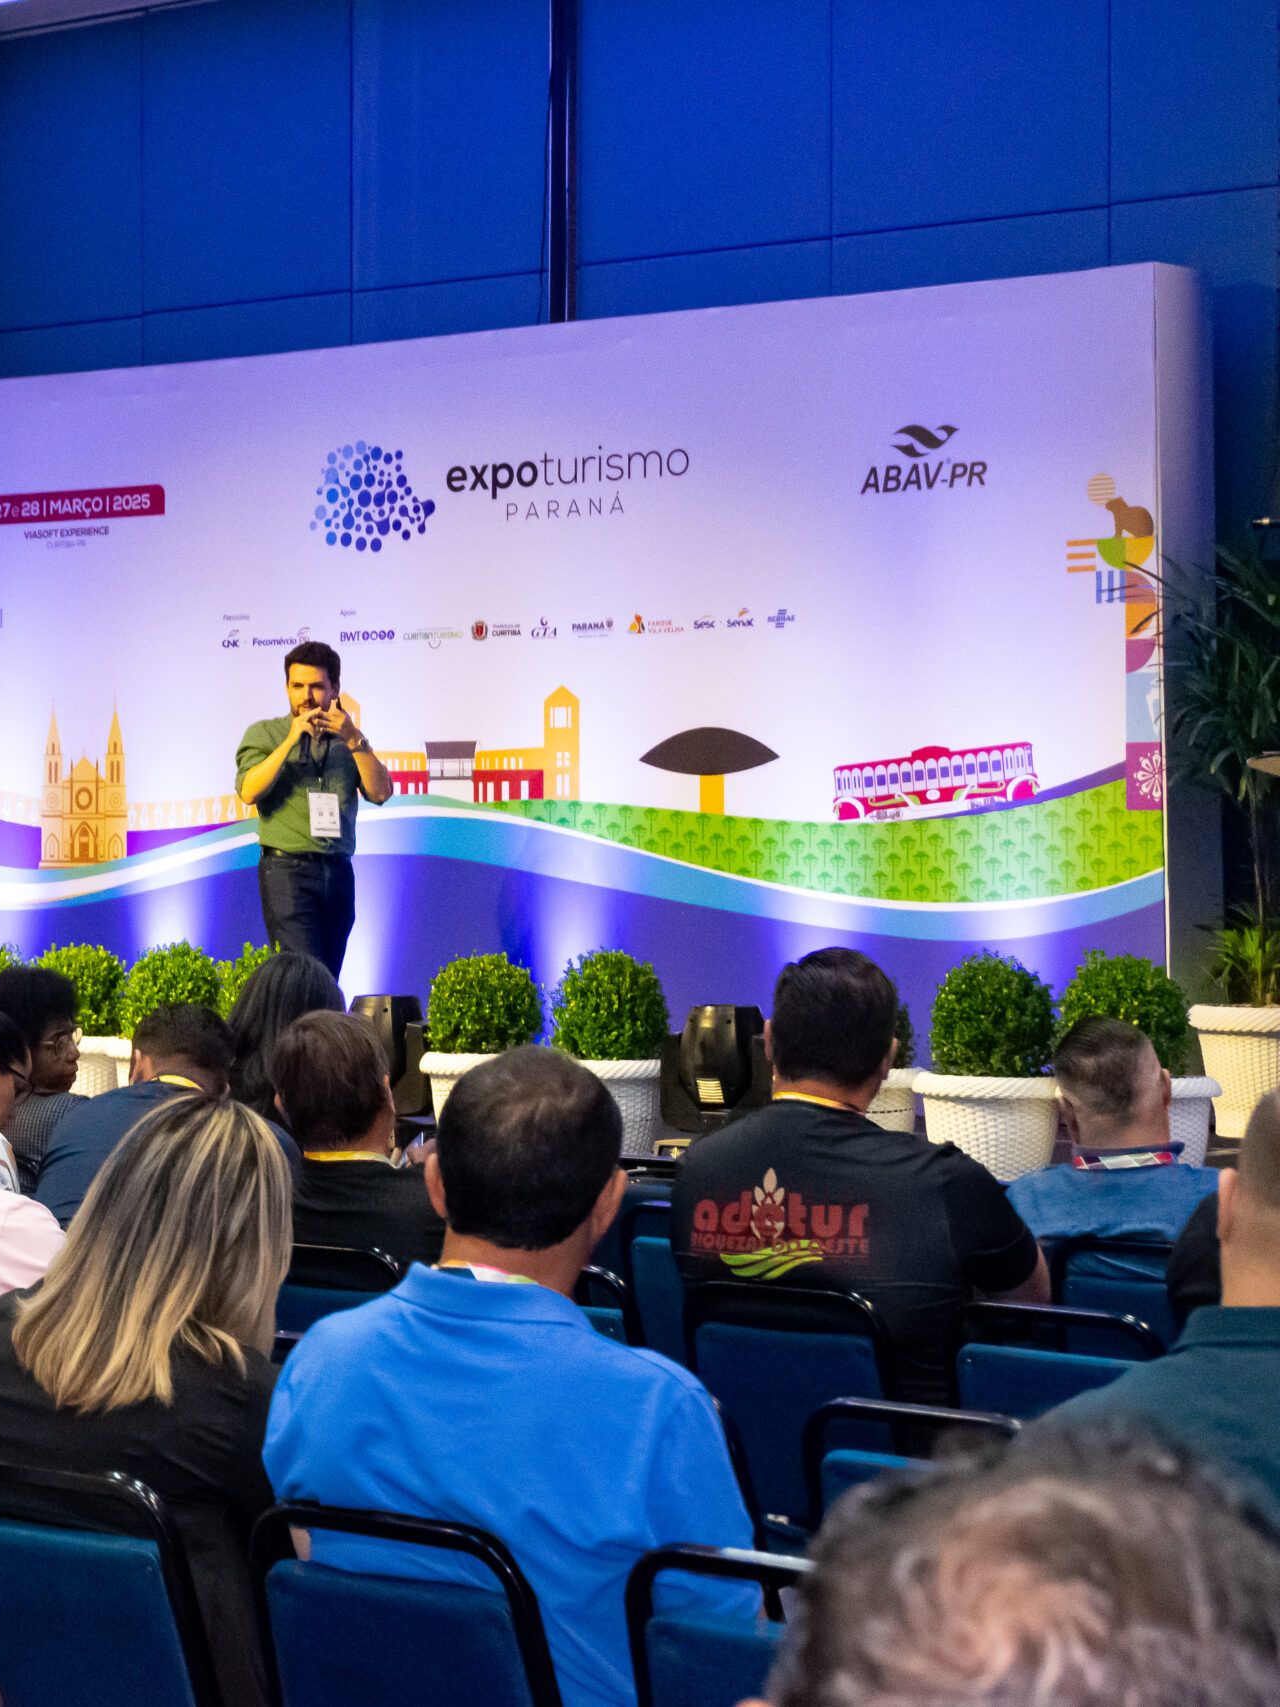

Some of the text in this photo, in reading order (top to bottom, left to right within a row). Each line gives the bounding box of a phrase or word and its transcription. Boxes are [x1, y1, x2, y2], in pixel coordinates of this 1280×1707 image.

[446, 445, 689, 499] expoturismo
[49, 497, 102, 517] MARÇO
[112, 493, 151, 511] 2025
[506, 491, 625, 522] PARANÁ
[24, 526, 110, 540] VIASOFT EXPERIENCE
[492, 629, 521, 637] CURITIBA
[572, 621, 605, 631] PARANÁ
[252, 637, 297, 646] Fecomércio
